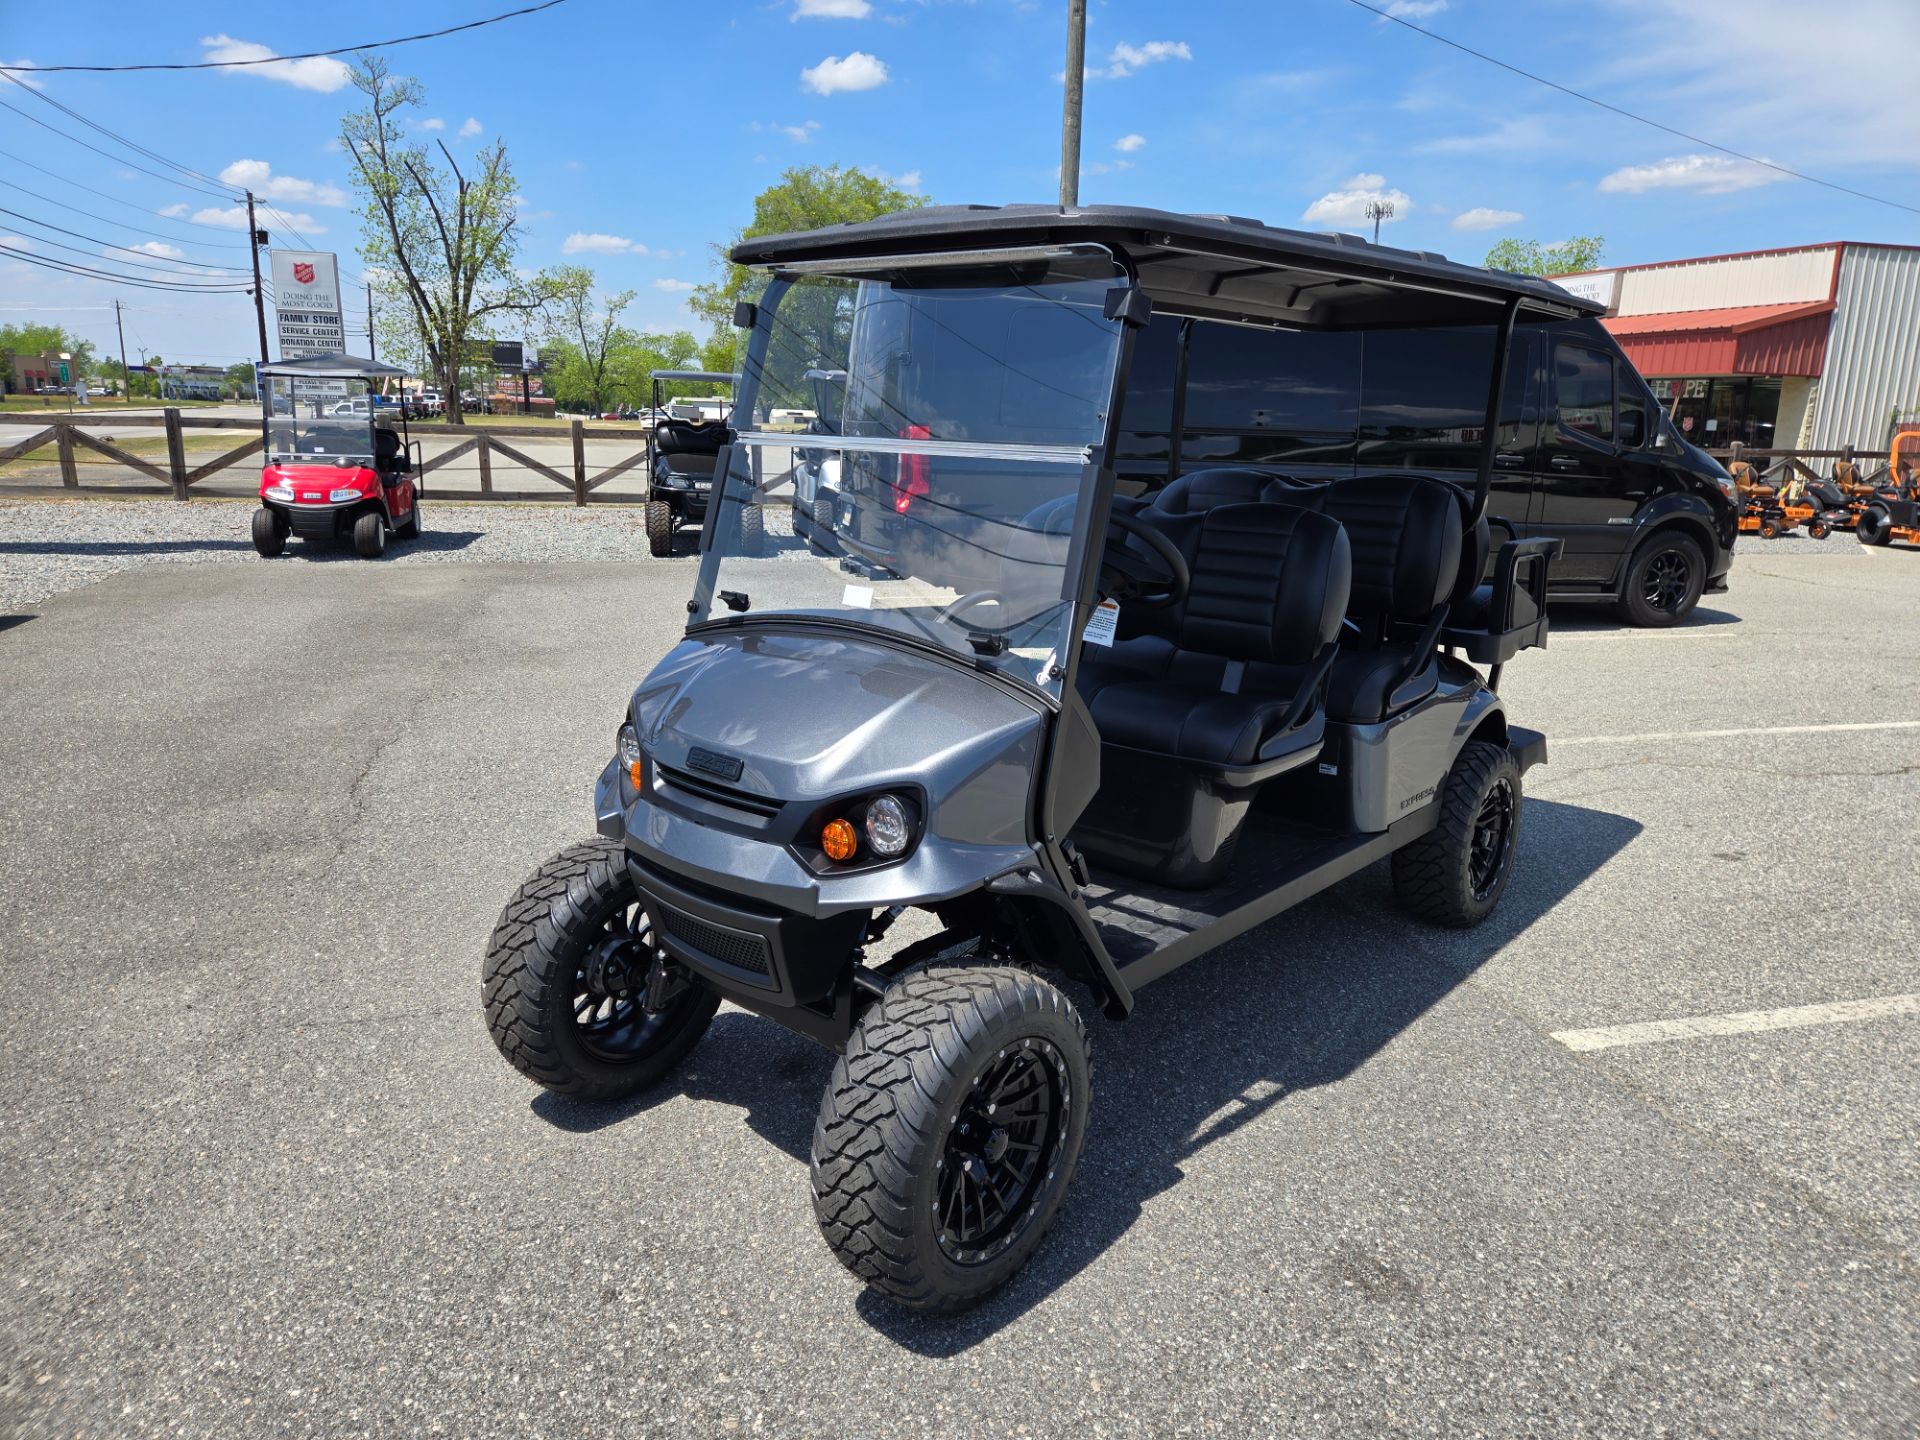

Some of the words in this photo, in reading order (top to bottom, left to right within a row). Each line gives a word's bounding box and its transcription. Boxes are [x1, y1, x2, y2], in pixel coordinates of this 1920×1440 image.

[283, 292, 313, 300] DOING
[314, 293, 329, 301] THE
[281, 300, 304, 308] MOST
[306, 301, 333, 309] GOOD
[280, 313, 309, 324] FAMILY
[313, 315, 340, 325] STORE
[281, 326, 310, 336] SERVICE
[312, 328, 339, 337] CENTER
[281, 338, 316, 347] DONATION
[317, 340, 343, 348] CENTER
[1400, 786, 1435, 810] EXPRESS
